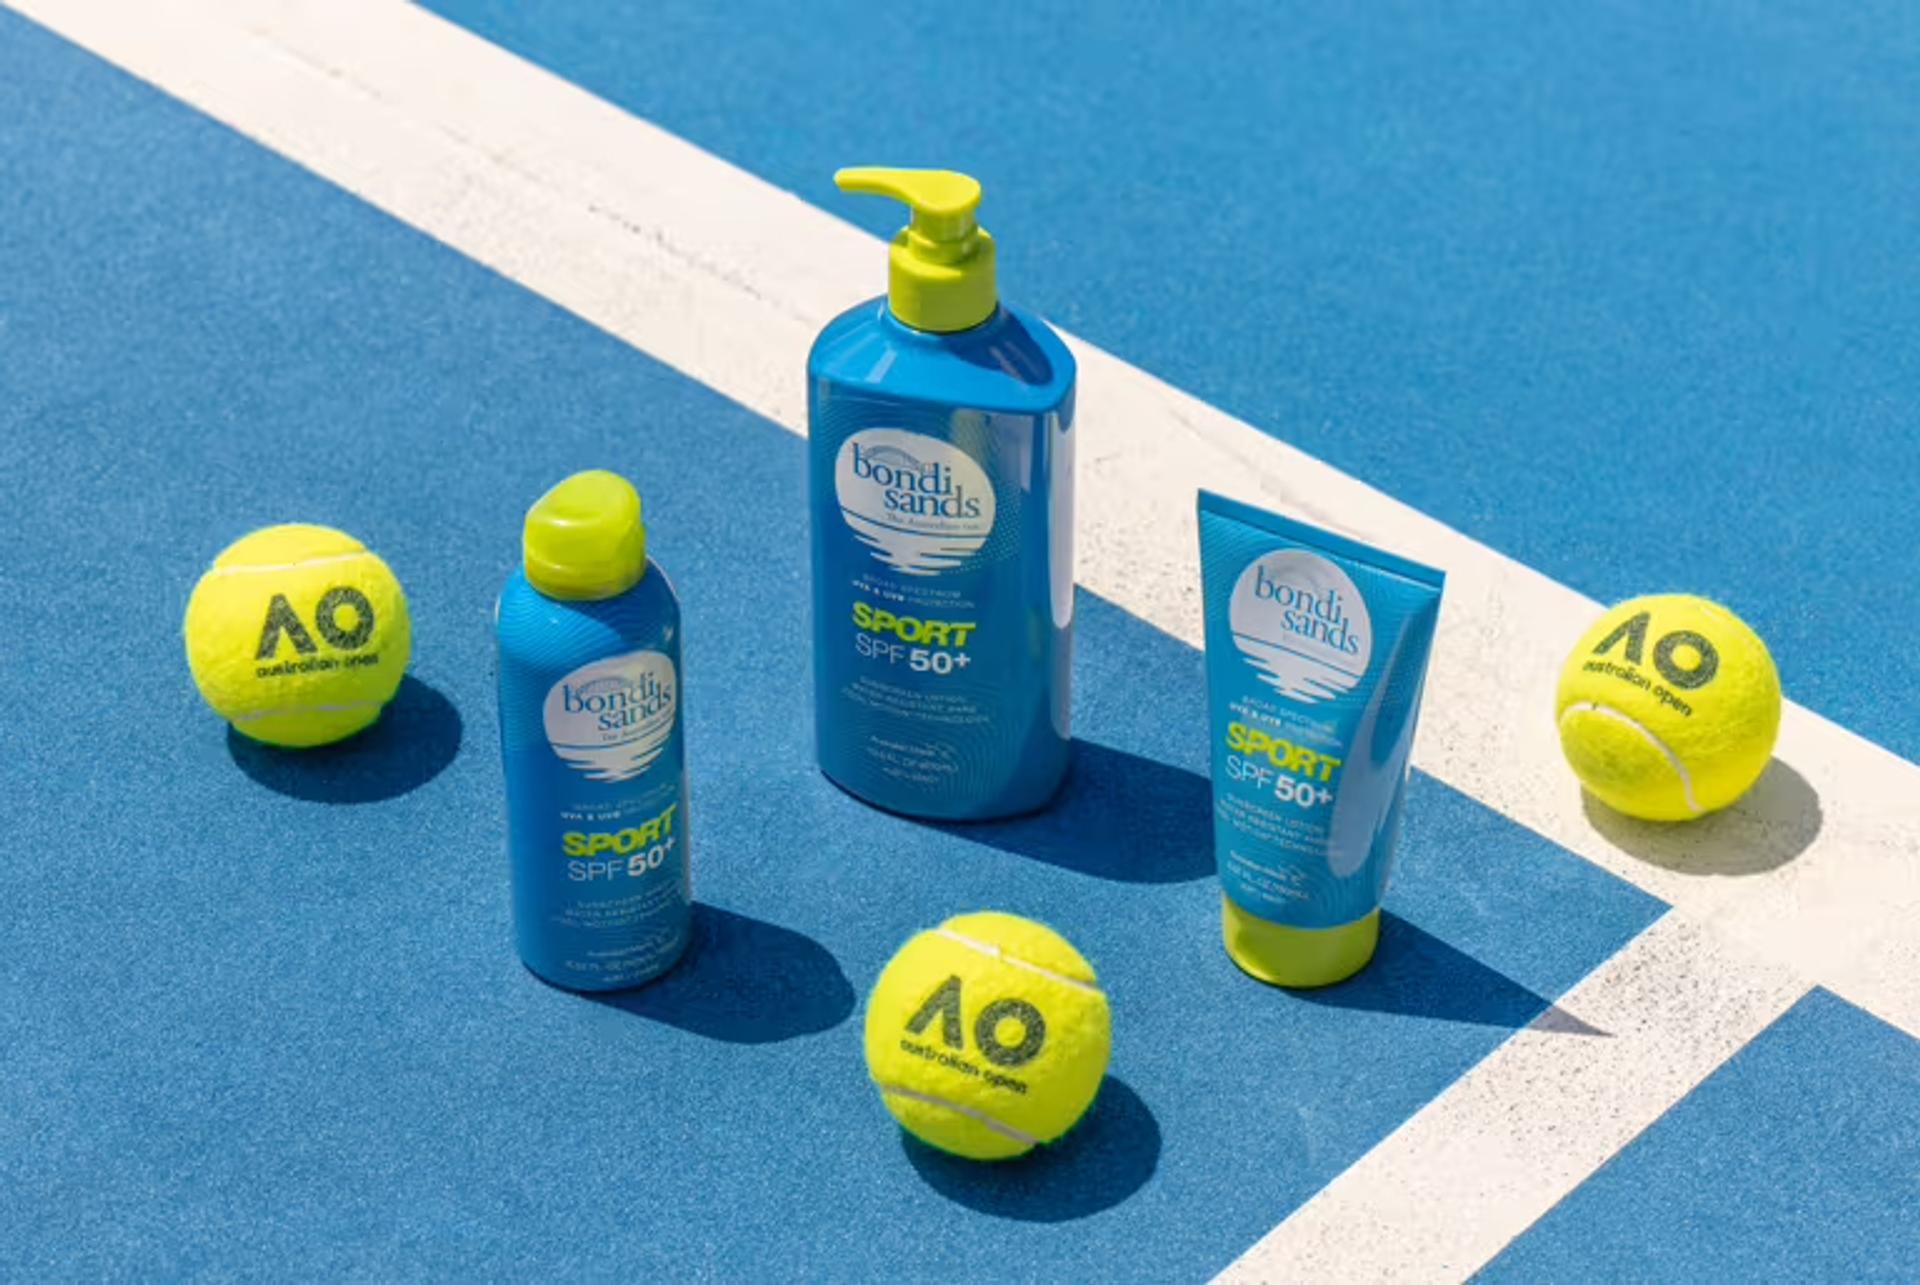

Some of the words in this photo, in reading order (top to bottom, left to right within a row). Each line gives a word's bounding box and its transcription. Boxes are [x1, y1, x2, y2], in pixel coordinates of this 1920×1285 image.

[853, 442, 953, 496] bondi
[884, 485, 981, 519] sands
[1254, 565, 1344, 626] bondi
[255, 585, 375, 660] AO
[852, 601, 977, 648] SPORT
[1280, 609, 1359, 656] sands
[855, 632, 905, 664] SPF
[909, 647, 972, 675] 50+
[1591, 611, 1720, 690] AO
[562, 671, 655, 714] bondi
[597, 681, 672, 732] sands
[1652, 685, 1693, 718] open
[1225, 721, 1342, 783] SPORT
[1225, 754, 1275, 790] SPF
[1275, 773, 1333, 808] 50+
[561, 803, 678, 857] SPORT
[567, 859, 624, 881] SPF
[627, 835, 676, 877] 50+
[903, 973, 1047, 1068] AO
